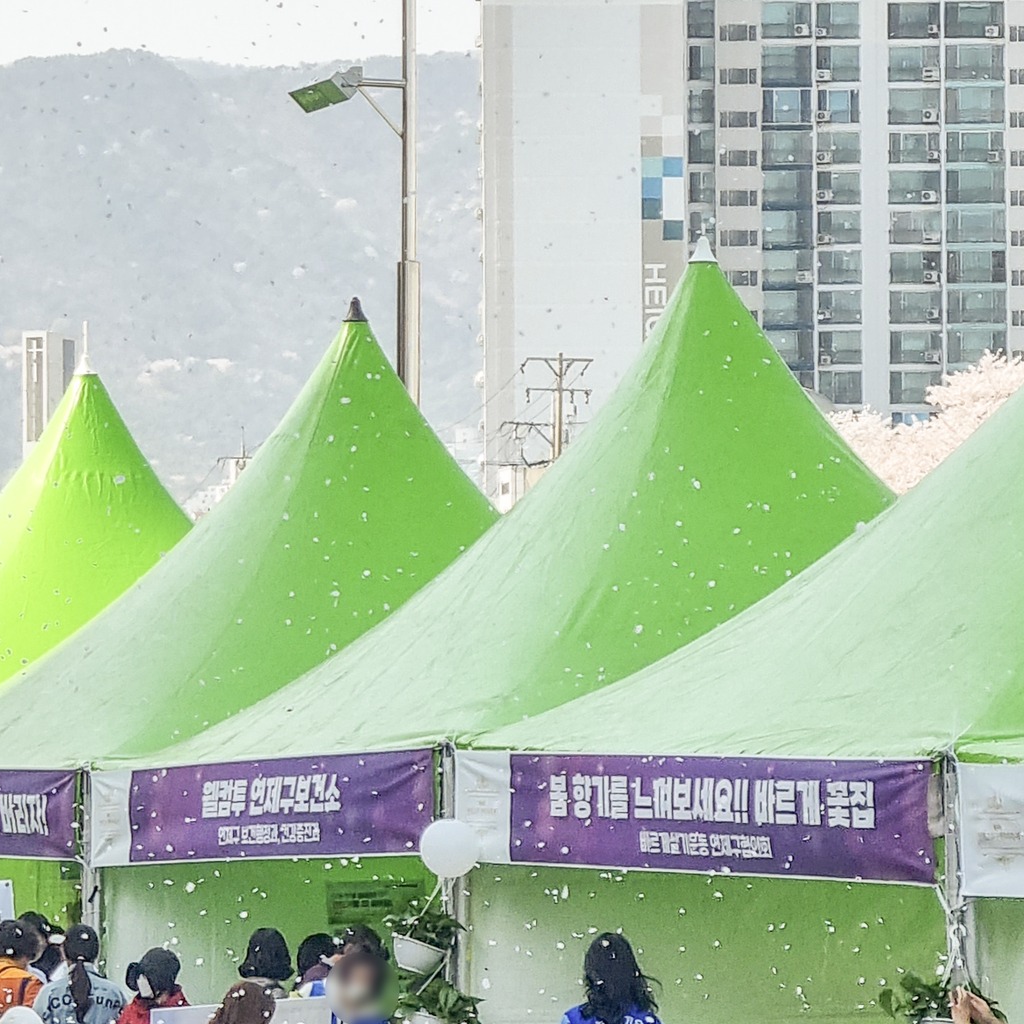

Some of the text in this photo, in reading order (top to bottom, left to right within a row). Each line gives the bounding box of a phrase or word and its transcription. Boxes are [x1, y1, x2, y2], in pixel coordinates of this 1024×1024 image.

[202, 773, 342, 818] 웰컴투 연제구보건소
[549, 772, 876, 829] 봄 향기를 느껴보세요!! 바르게 꽃집
[218, 826, 240, 846] 연제구
